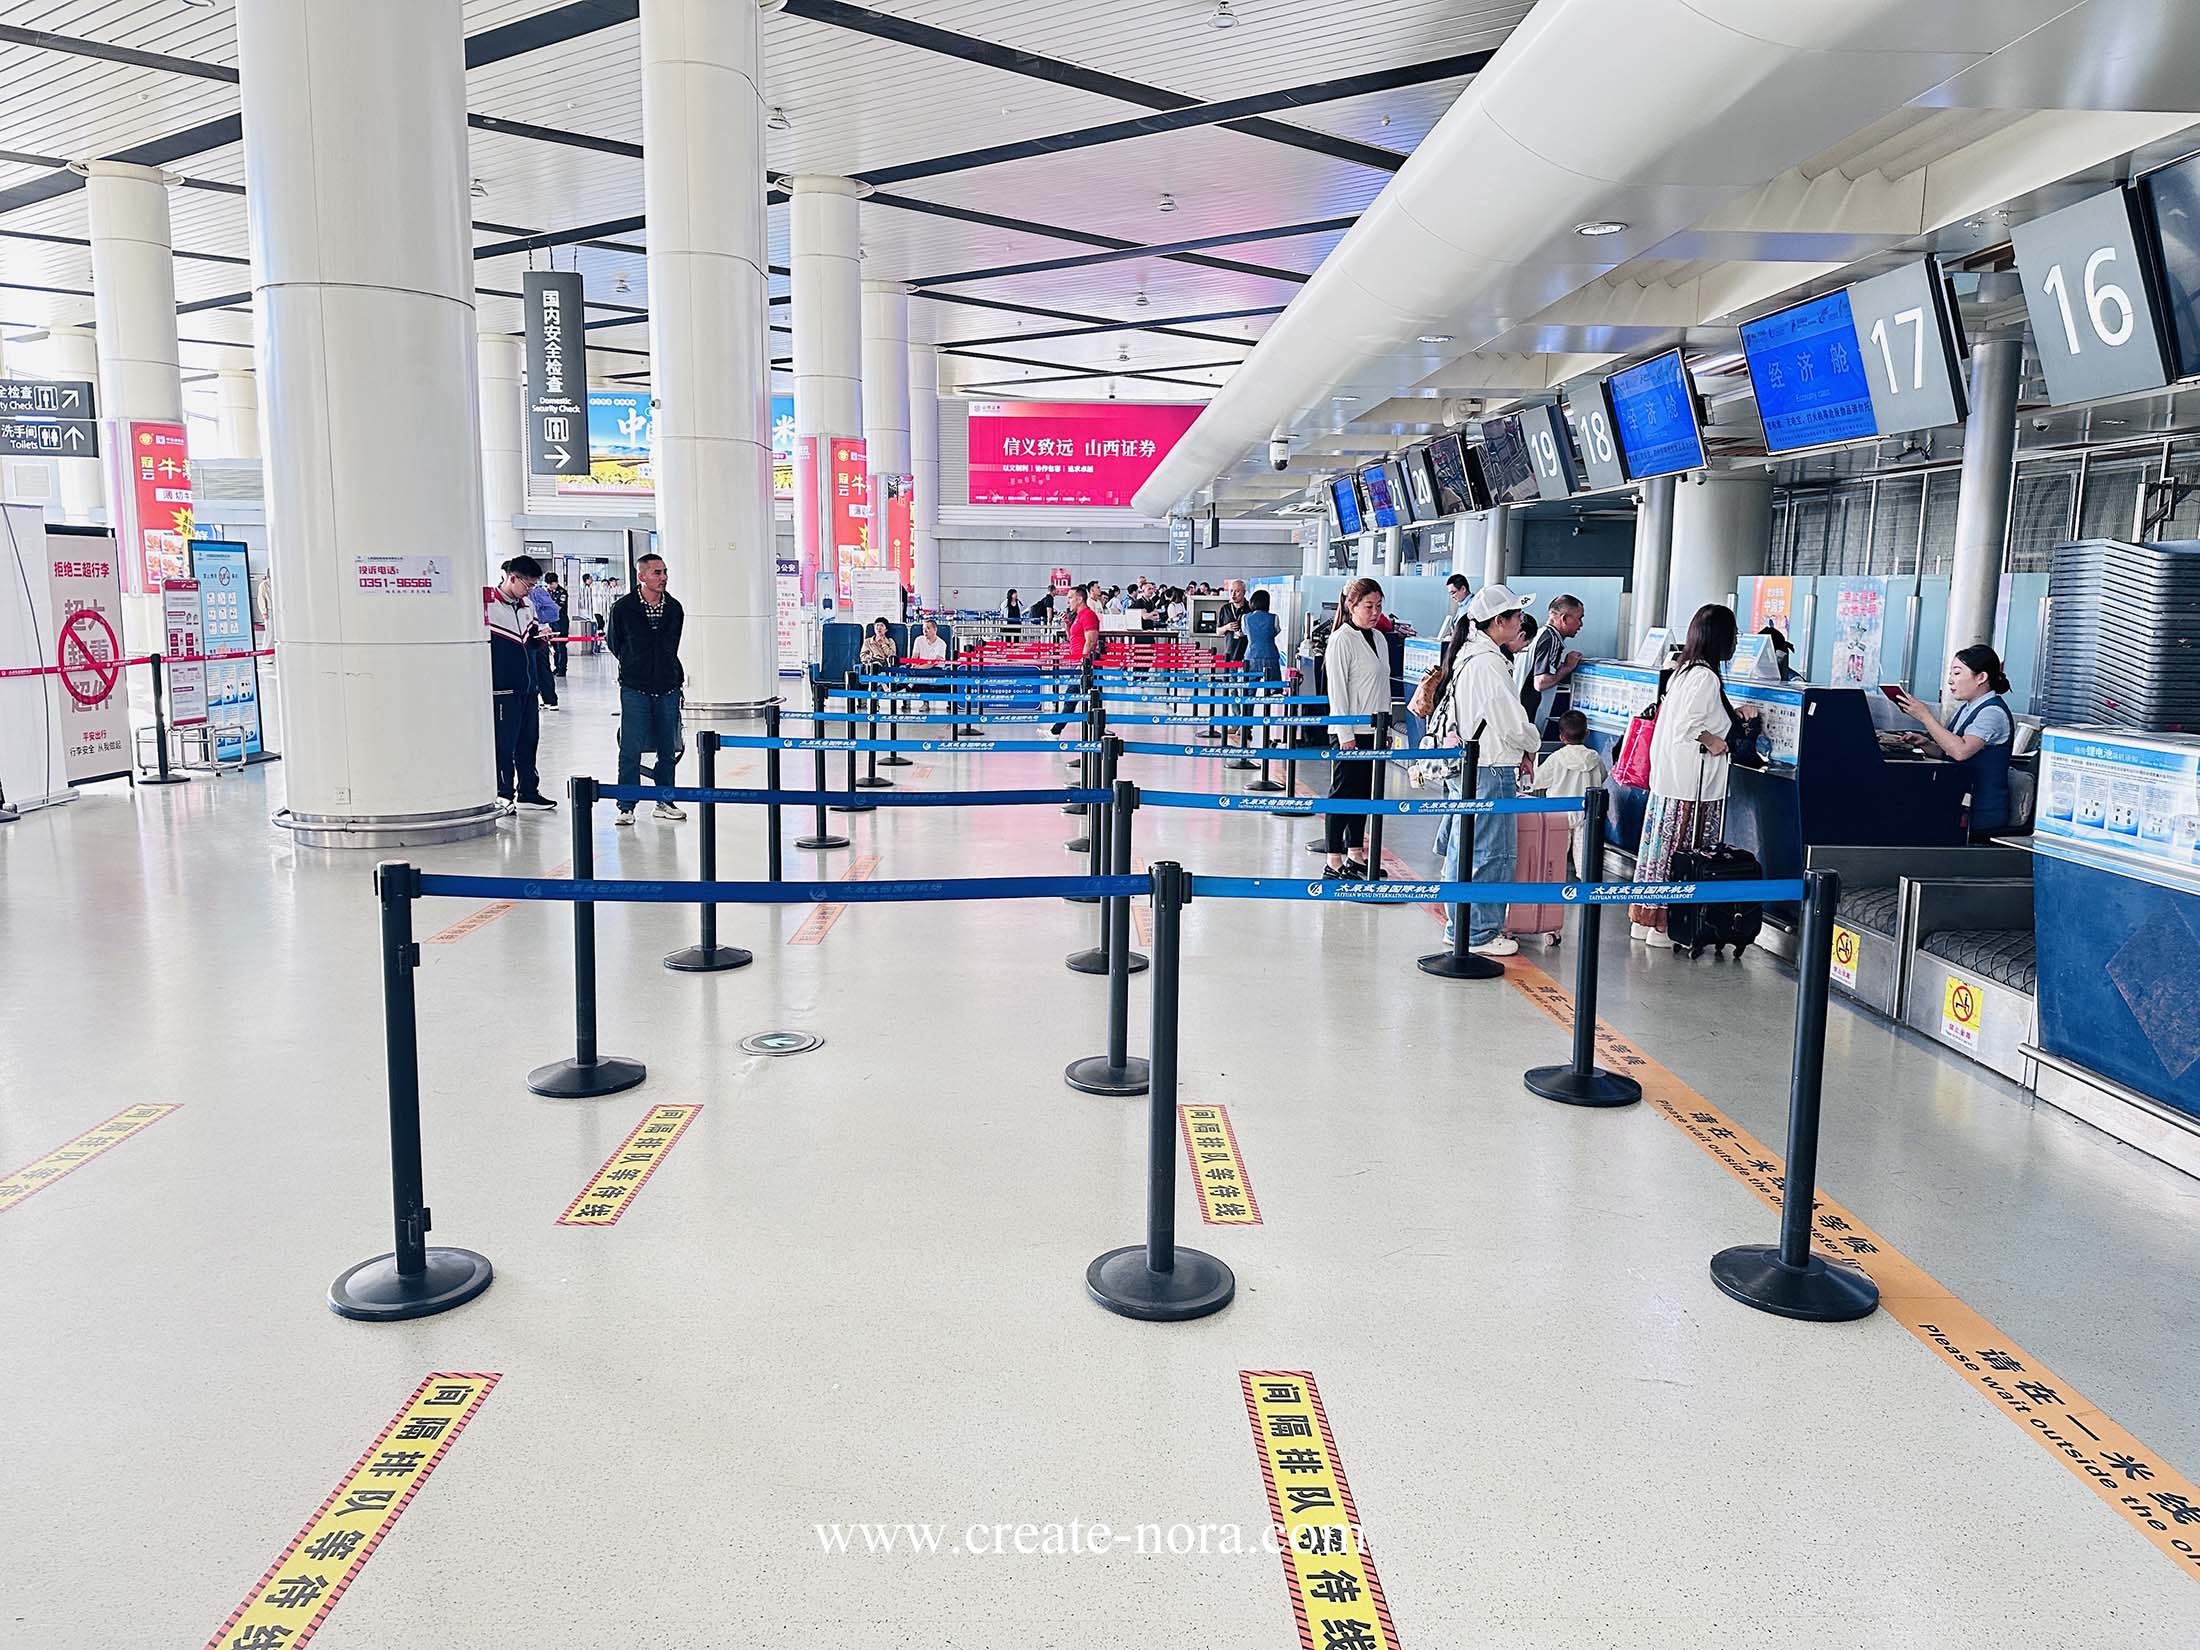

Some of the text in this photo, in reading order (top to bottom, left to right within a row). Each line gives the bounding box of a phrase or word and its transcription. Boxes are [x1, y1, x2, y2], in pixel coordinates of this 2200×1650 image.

[2042, 247, 2134, 355] 16
[542, 289, 563, 393] 国内安全检查
[1871, 306, 1925, 395] 17
[1767, 341, 1850, 389] 经济舱
[9, 400, 34, 411] Check
[532, 404, 581, 414] Security Check
[539, 396, 572, 405] Domestic
[1, 425, 37, 439] 洗手间
[10, 440, 38, 449] Toilets
[1003, 437, 1156, 458] 信义致远 山西证券
[1581, 411, 1612, 465] 18
[1531, 432, 1559, 479] 19
[1388, 479, 1404, 511] 21
[1412, 468, 1432, 505] 20
[54, 561, 110, 578] 拒绝三超行李
[1177, 551, 1184, 562] 2
[1336, 884, 1441, 893] 太原武宿国际机场
[1590, 884, 1696, 895] 太原武宿国际机场
[575, 1109, 687, 1217] 间隔排队等待线
[1189, 1109, 1246, 1217] 间隔排队等待线
[1656, 1099, 1687, 1123] Please
[1686, 1124, 1712, 1142] wait
[1708, 1144, 1750, 1176] outside
[1748, 1178, 1771, 1193] the
[1918, 1324, 1980, 1372] Please
[1982, 1375, 2032, 1414] wait
[2030, 1418, 2118, 1489] outside
[2120, 1495, 2167, 1531] the
[230, 1385, 475, 1650] 间隔排队等待线
[1259, 1383, 1377, 1650] 间隔排队等待线
